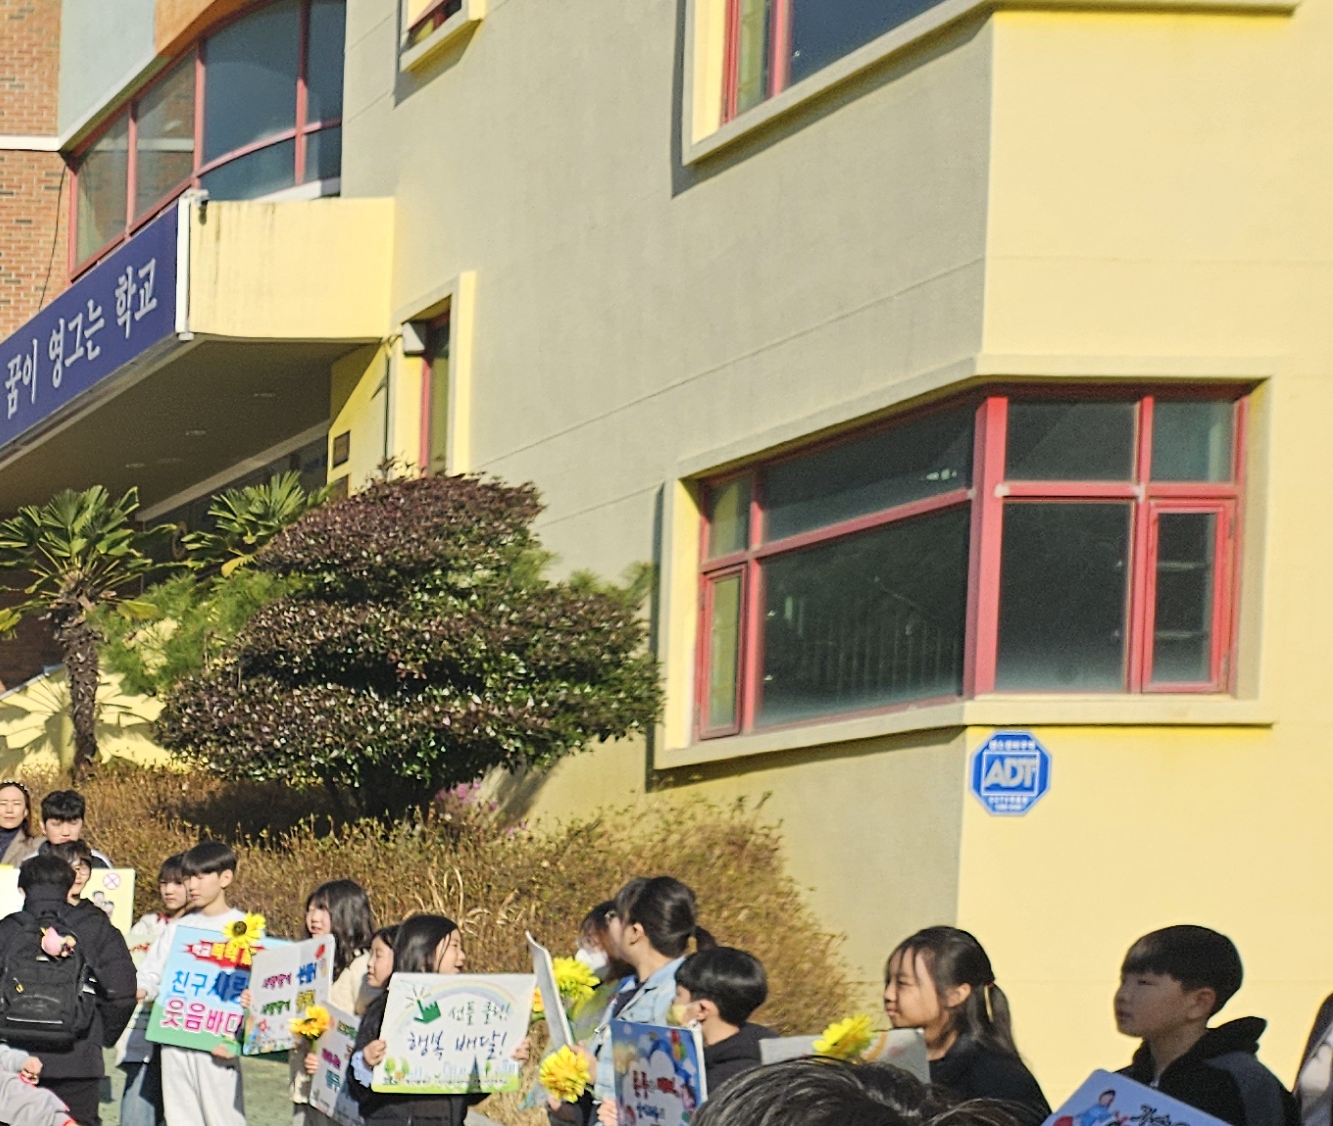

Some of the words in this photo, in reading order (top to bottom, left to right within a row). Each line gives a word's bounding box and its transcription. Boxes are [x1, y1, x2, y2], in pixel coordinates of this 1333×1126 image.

[4, 337, 39, 420] 꿈이
[48, 298, 106, 389] 영그는
[114, 257, 158, 340] 학교
[984, 758, 1038, 788] ADT
[407, 1030, 445, 1061] 행복
[455, 1029, 508, 1061] 배달!
